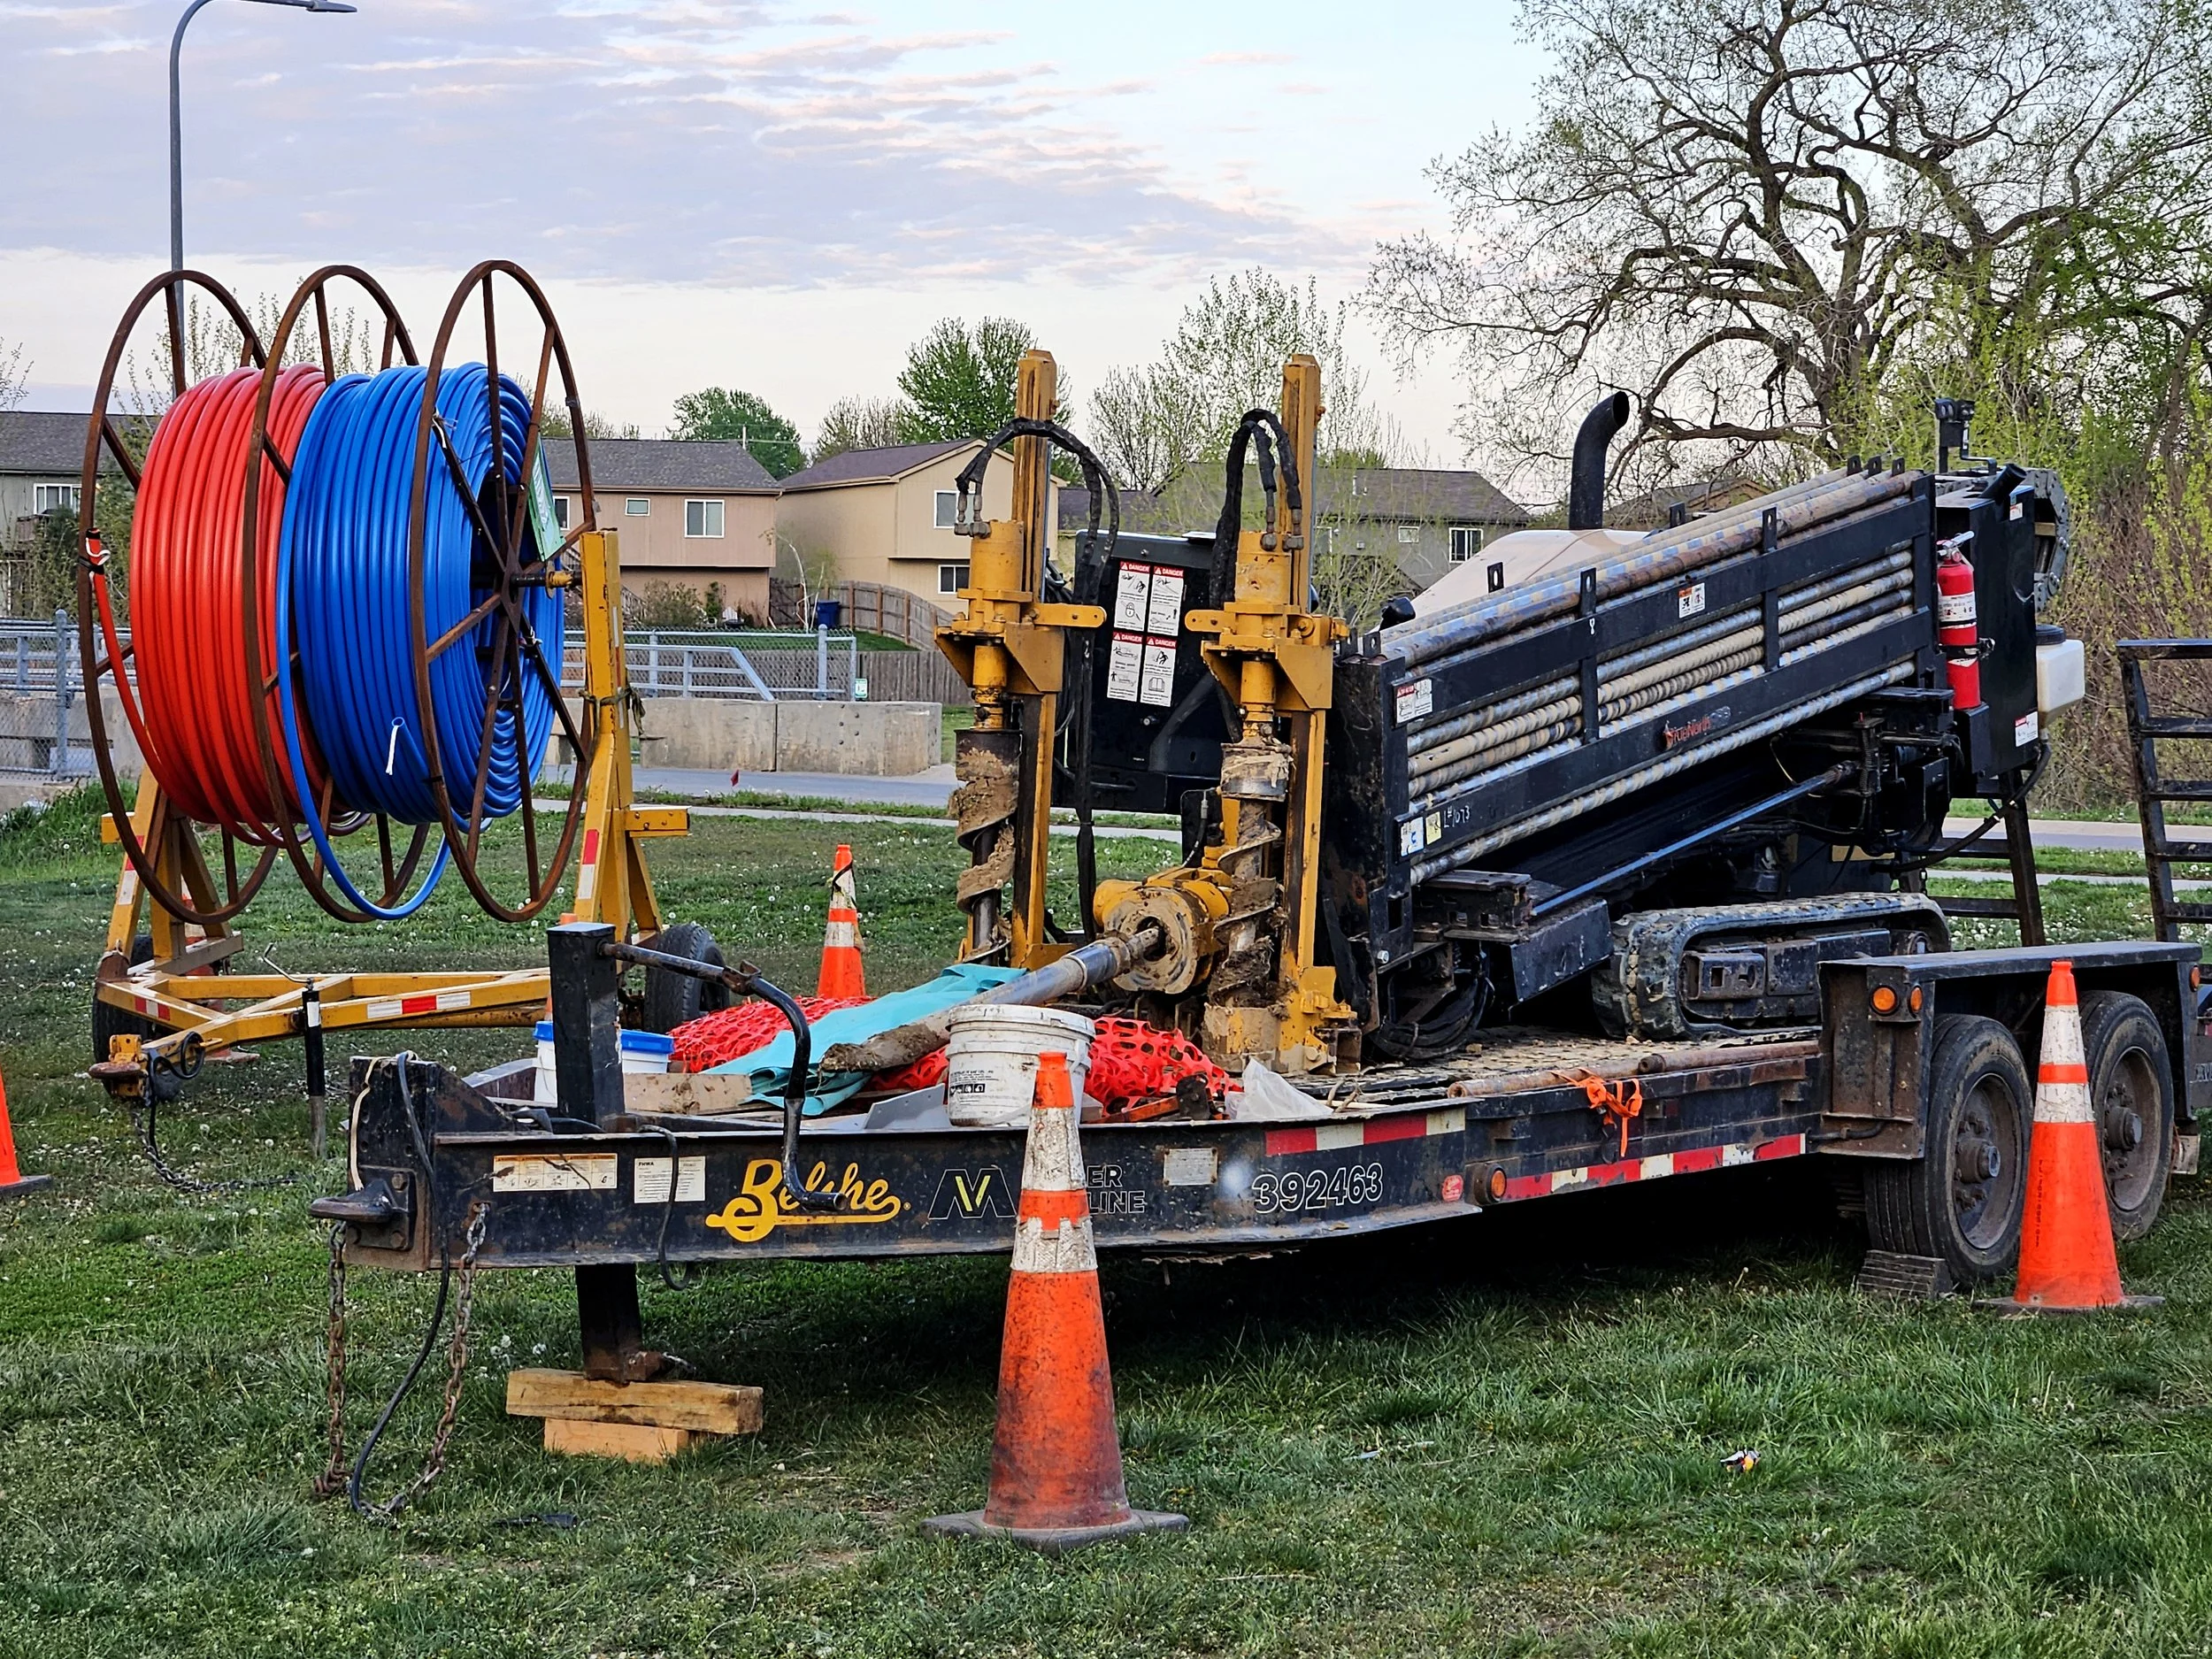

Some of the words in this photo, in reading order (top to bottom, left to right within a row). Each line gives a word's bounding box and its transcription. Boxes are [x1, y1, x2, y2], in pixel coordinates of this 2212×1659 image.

[1128, 564, 1150, 572] DANGER
[1162, 568, 1184, 577] DANGER
[1087, 1164, 1123, 1188] ER
[1252, 1163, 1383, 1214] 392463
